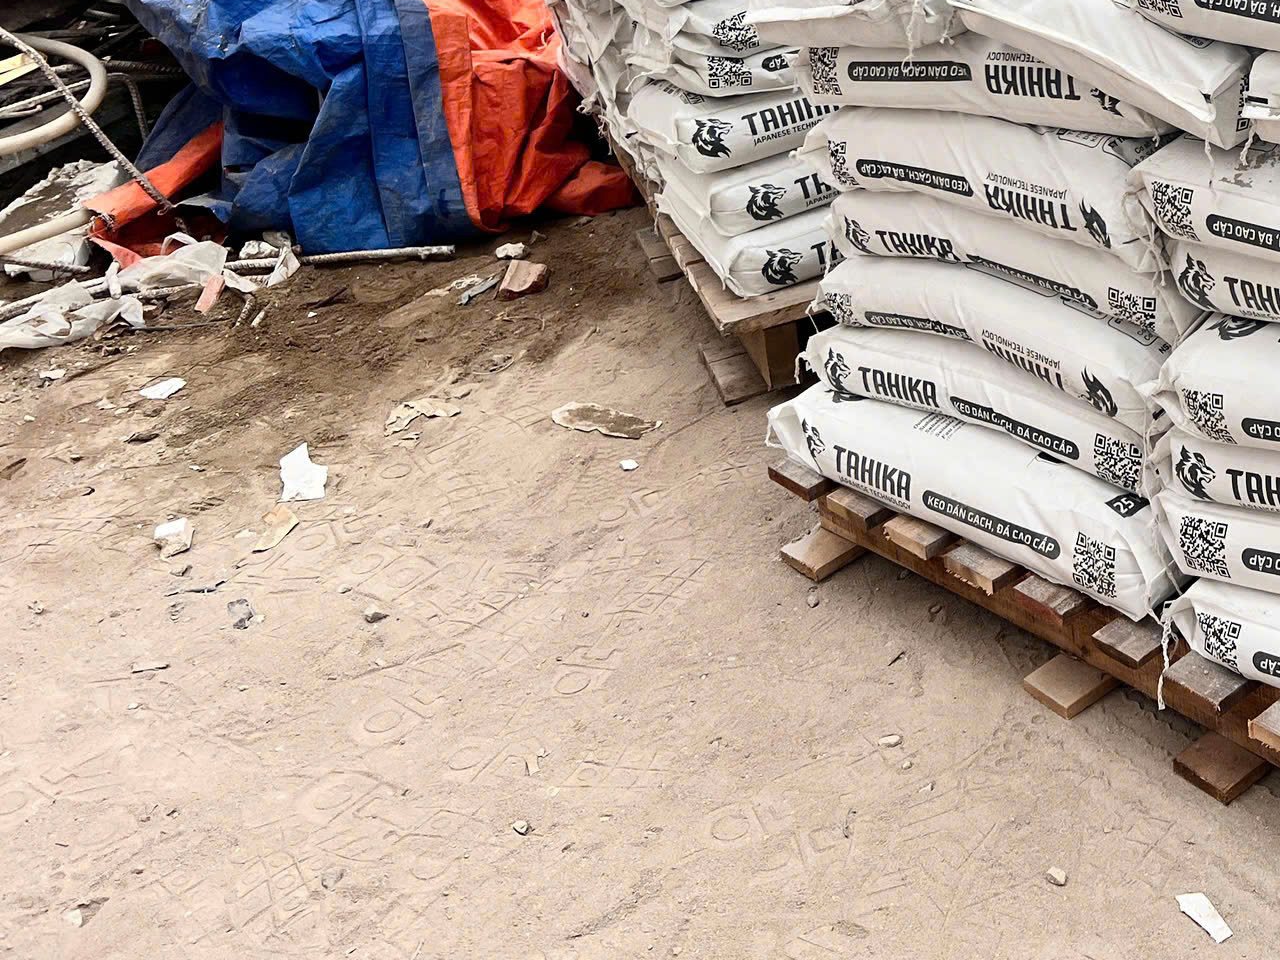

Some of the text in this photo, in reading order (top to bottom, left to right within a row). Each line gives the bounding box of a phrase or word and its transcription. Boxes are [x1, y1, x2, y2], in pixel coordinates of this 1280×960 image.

[1250, 0, 1267, 16] ĐÁ
[865, 67, 886, 78] CAO
[985, 64, 1081, 100] TAHIKA
[753, 129, 791, 146] JAPANESE
[951, 178, 969, 192] KEO
[1030, 182, 1067, 200] JAPANESE
[983, 184, 1077, 231] TAHIKA
[1212, 220, 1233, 237] CẤP
[1235, 226, 1256, 240] CAO
[875, 230, 962, 261] TAHIKA
[1258, 230, 1273, 246] ĐÁ
[982, 328, 1025, 354] TECHNOLOGY
[1026, 348, 1061, 369] JAPANESE
[857, 366, 939, 408] TAHIKA
[970, 405, 990, 421] DÁN
[1017, 425, 1030, 440] ĐÁ
[1032, 431, 1051, 446] CAO
[1052, 436, 1073, 455] CẤP
[1249, 423, 1272, 439] CẤP
[833, 444, 911, 501] TAHIKA
[869, 488, 911, 510] TECHNOLOGY
[1114, 497, 1135, 515] 25
[927, 495, 946, 512] KEO
[946, 500, 967, 520] DÁN
[996, 522, 1011, 537] ĐÁ
[1012, 528, 1031, 545] CAO
[1032, 536, 1055, 555] CẤP
[1249, 555, 1272, 572] CẤP
